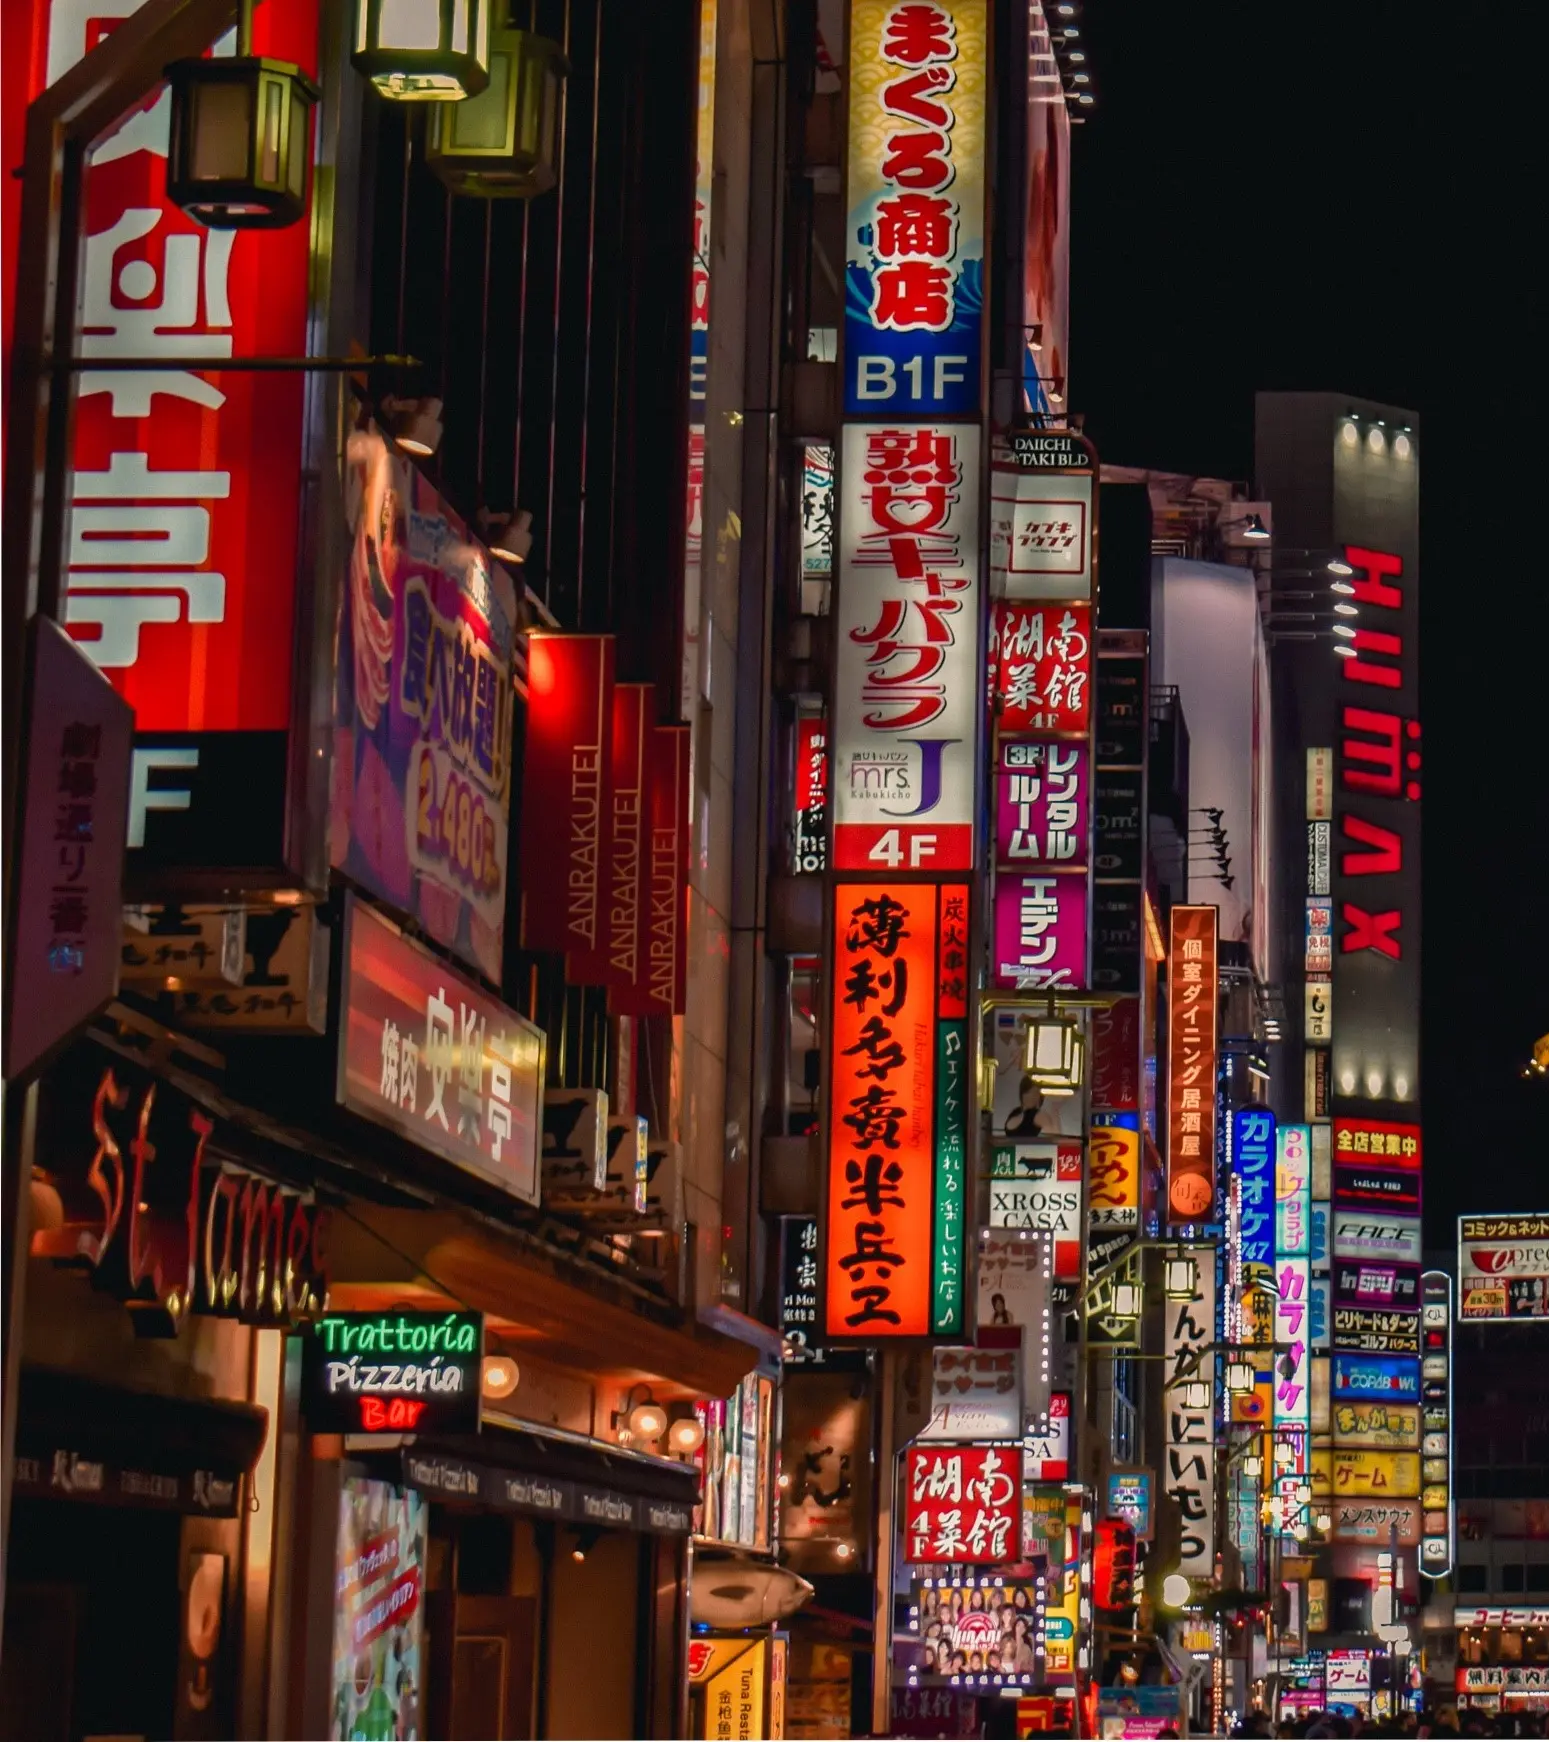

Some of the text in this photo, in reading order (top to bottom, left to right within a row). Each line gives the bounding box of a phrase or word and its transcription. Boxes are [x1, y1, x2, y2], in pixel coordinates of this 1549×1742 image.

[870, 2, 958, 332] まぐろ商店
[857, 356, 968, 400] B1F
[1015, 437, 1072, 451] DAIICHI
[1057, 452, 1089, 467] BLD
[1024, 521, 1072, 533] カブキ
[850, 429, 972, 732] 熟女キャバクラ
[1003, 611, 1088, 662] 湖南
[1028, 714, 1060, 729] 4F
[1008, 746, 1041, 764] 3F
[851, 789, 911, 800] Kabukicho
[879, 739, 963, 817] J
[1008, 776, 1040, 859] ルーム
[1047, 745, 1081, 860] レンタル
[568, 743, 600, 936] ANRAKUTEI
[868, 829, 939, 870] 4F
[610, 787, 642, 975] ANRAKUTEI
[648, 826, 678, 1002] ANRAKUTEI
[1020, 878, 1058, 965] エデン
[380, 1016, 419, 1116] 焼肉
[1179, 938, 1204, 1157] 個室ダイニング居酒屋
[1337, 1129, 1418, 1158] 全店営業中
[1240, 1115, 1271, 1238] カラオケ
[992, 1193, 1078, 1212] XROSS
[1003, 1212, 1069, 1231] CASA
[321, 1312, 477, 1352] Trattoria
[327, 1355, 463, 1394] Pizzeria
[361, 1397, 426, 1430] Bar
[912, 1452, 1014, 1506] 湖南
[1335, 1465, 1388, 1489] ゲーム
[1472, 1608, 1526, 1626] コーヒー
[740, 1667, 754, 1700] Tuna
[1329, 1670, 1369, 1686] ゲーム
[717, 1689, 733, 1741] 金枪鱼
